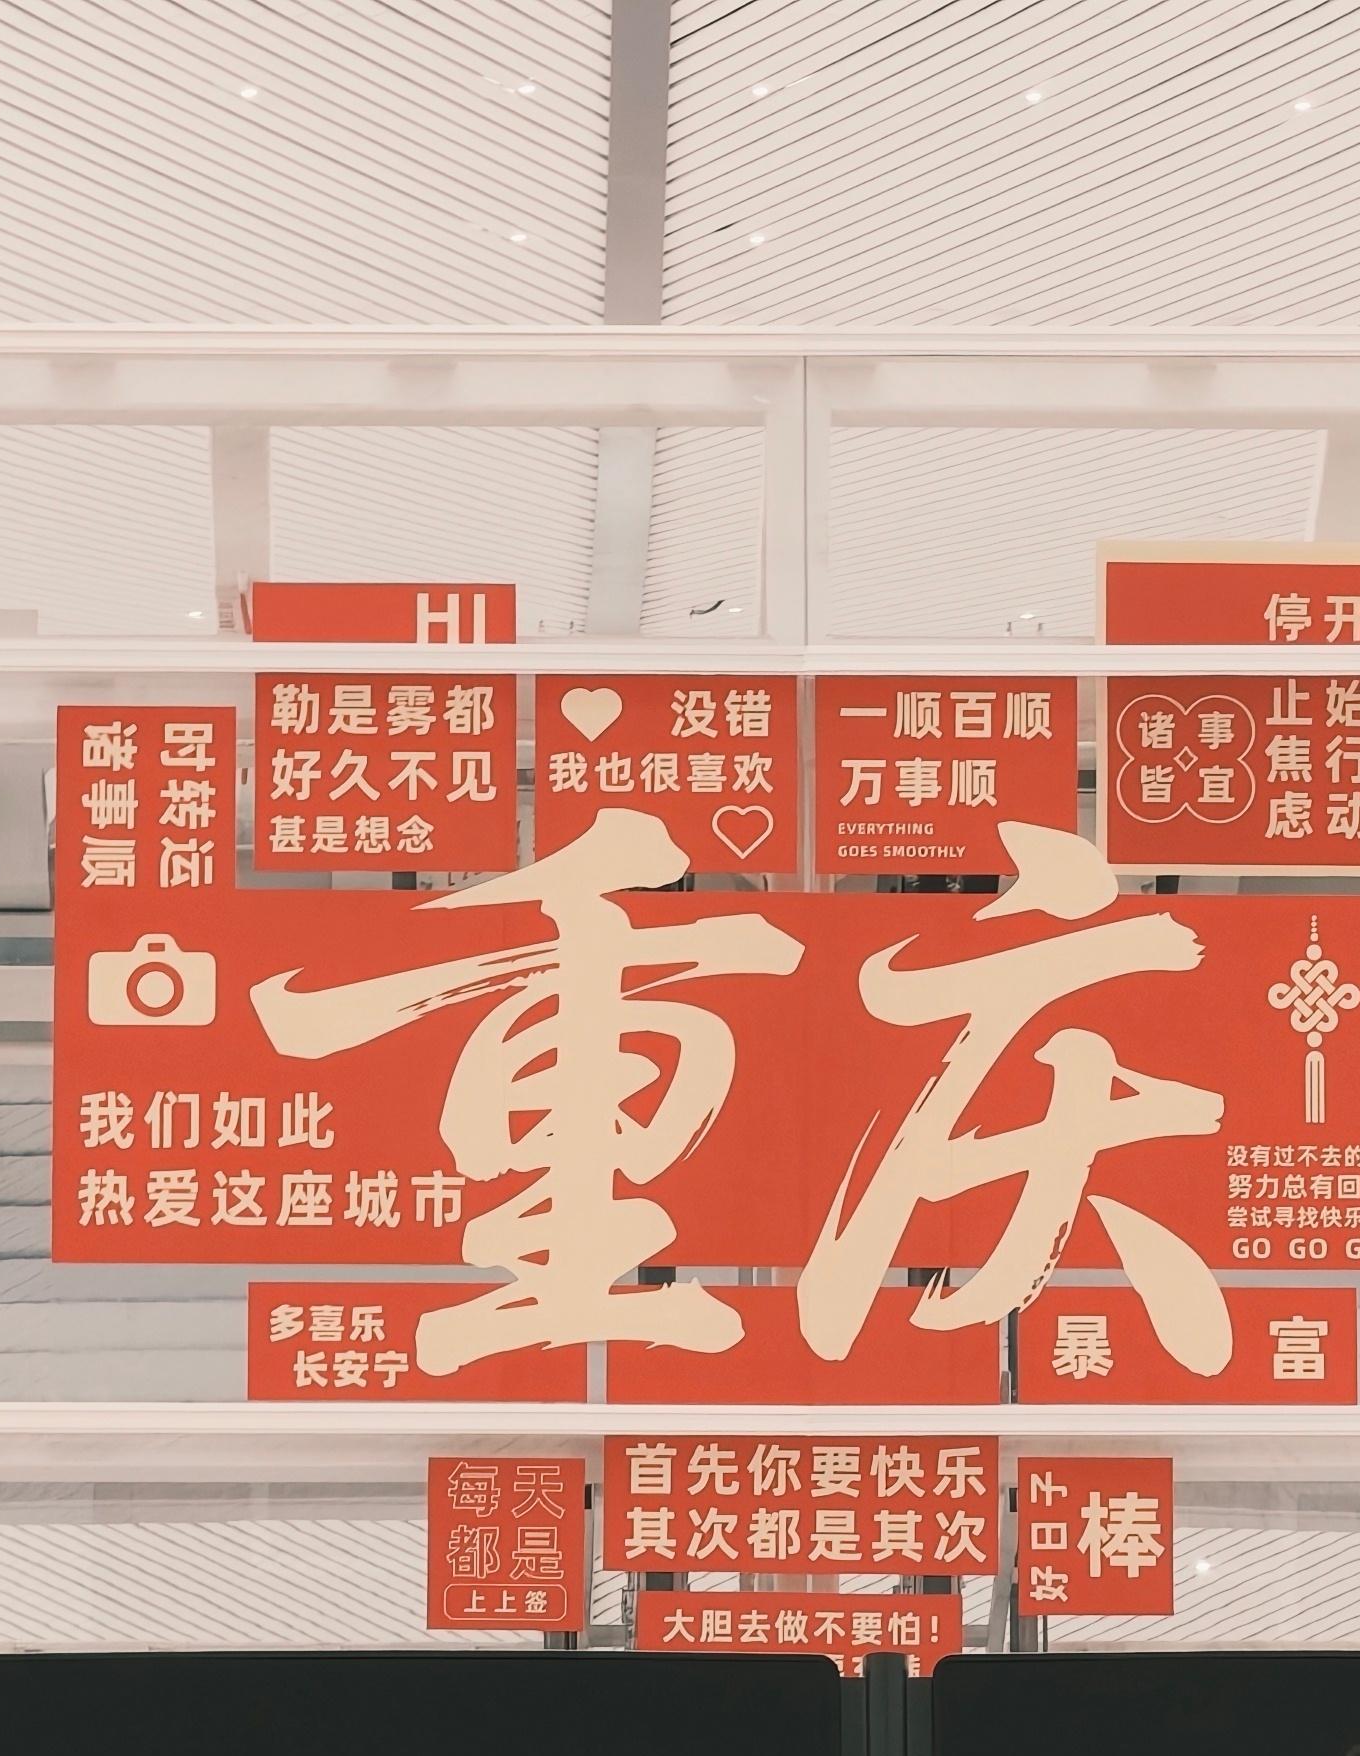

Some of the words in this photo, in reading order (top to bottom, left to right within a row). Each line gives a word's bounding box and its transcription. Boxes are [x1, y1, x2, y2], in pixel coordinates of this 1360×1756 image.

[416, 593, 486, 643] HI
[271, 684, 494, 735] 勒是雾都
[671, 690, 771, 737] 没错
[840, 692, 1052, 739] 一顺百顺
[271, 749, 496, 802] 好久不见
[549, 752, 773, 793] 我也很喜欢
[840, 757, 997, 807] 万事顺
[81, 722, 138, 887] 诸事顺
[159, 724, 216, 887] 时转运
[838, 822, 934, 835] EVERYTHING
[269, 815, 433, 853] 甚是想念
[837, 845, 878, 858] GOES
[883, 845, 966, 858] SMOOTHLY
[250, 807, 1233, 1377] 重庆
[80, 1091, 334, 1149] 我们如此
[77, 1169, 466, 1227] 热爱这座城市
[1232, 1237, 1271, 1259] GO
[1288, 1237, 1328, 1260] GO
[270, 1304, 385, 1342] 多喜乐
[293, 1351, 409, 1387] 长安宁
[448, 1462, 564, 1519] 每天
[626, 1443, 986, 1498] 首先你要快乐
[447, 1525, 564, 1579] 都是
[625, 1507, 986, 1562] 其次都是其次
[1030, 1472, 1068, 1601] 好日子
[1077, 1492, 1165, 1578] 棒
[464, 1590, 547, 1613] 上上签
[663, 1609, 938, 1645] 大胆去做不要怕！
